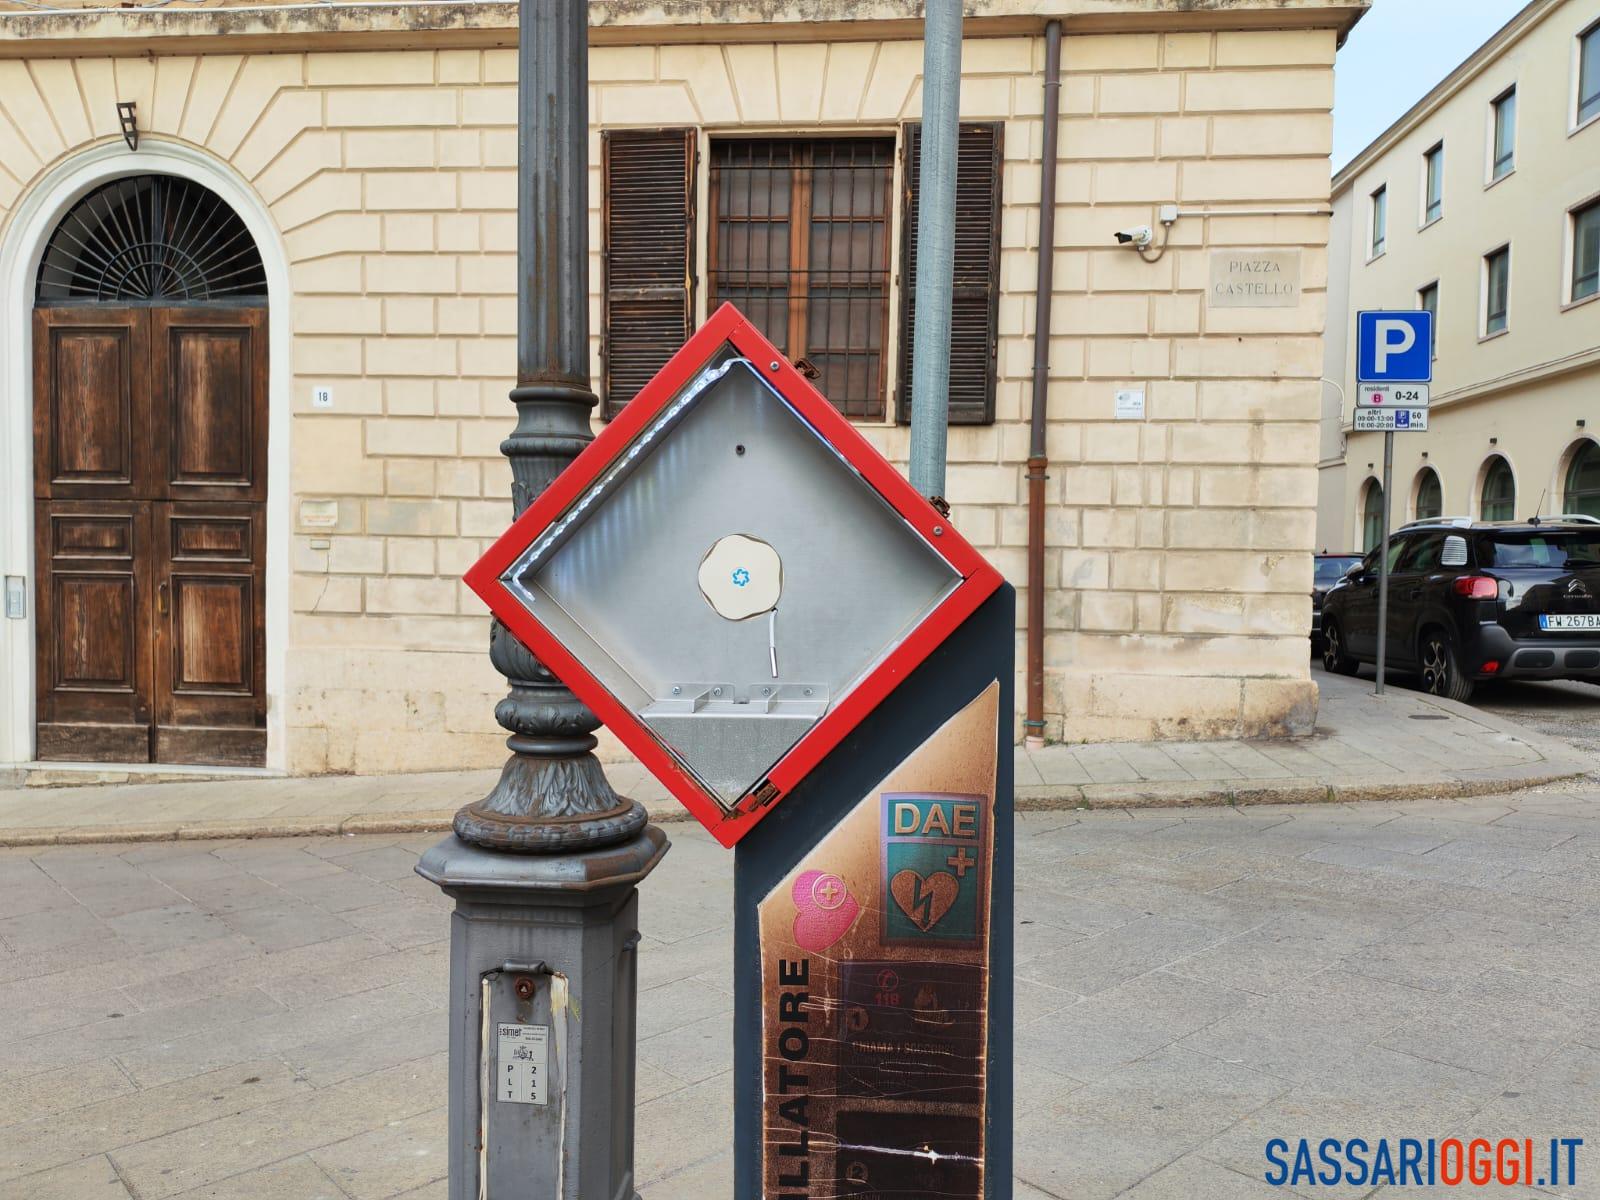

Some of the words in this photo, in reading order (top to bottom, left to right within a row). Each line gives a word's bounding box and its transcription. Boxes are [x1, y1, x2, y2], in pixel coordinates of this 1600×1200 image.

[1229, 260, 1281, 273] PIAZZA
[1215, 282, 1293, 295] CASTELLO
[1375, 320, 1416, 373] P
[1395, 391, 1419, 401] 0-24
[1411, 411, 1422, 420] 60
[1548, 615, 1562, 627] FW
[894, 802, 976, 837] DAE
